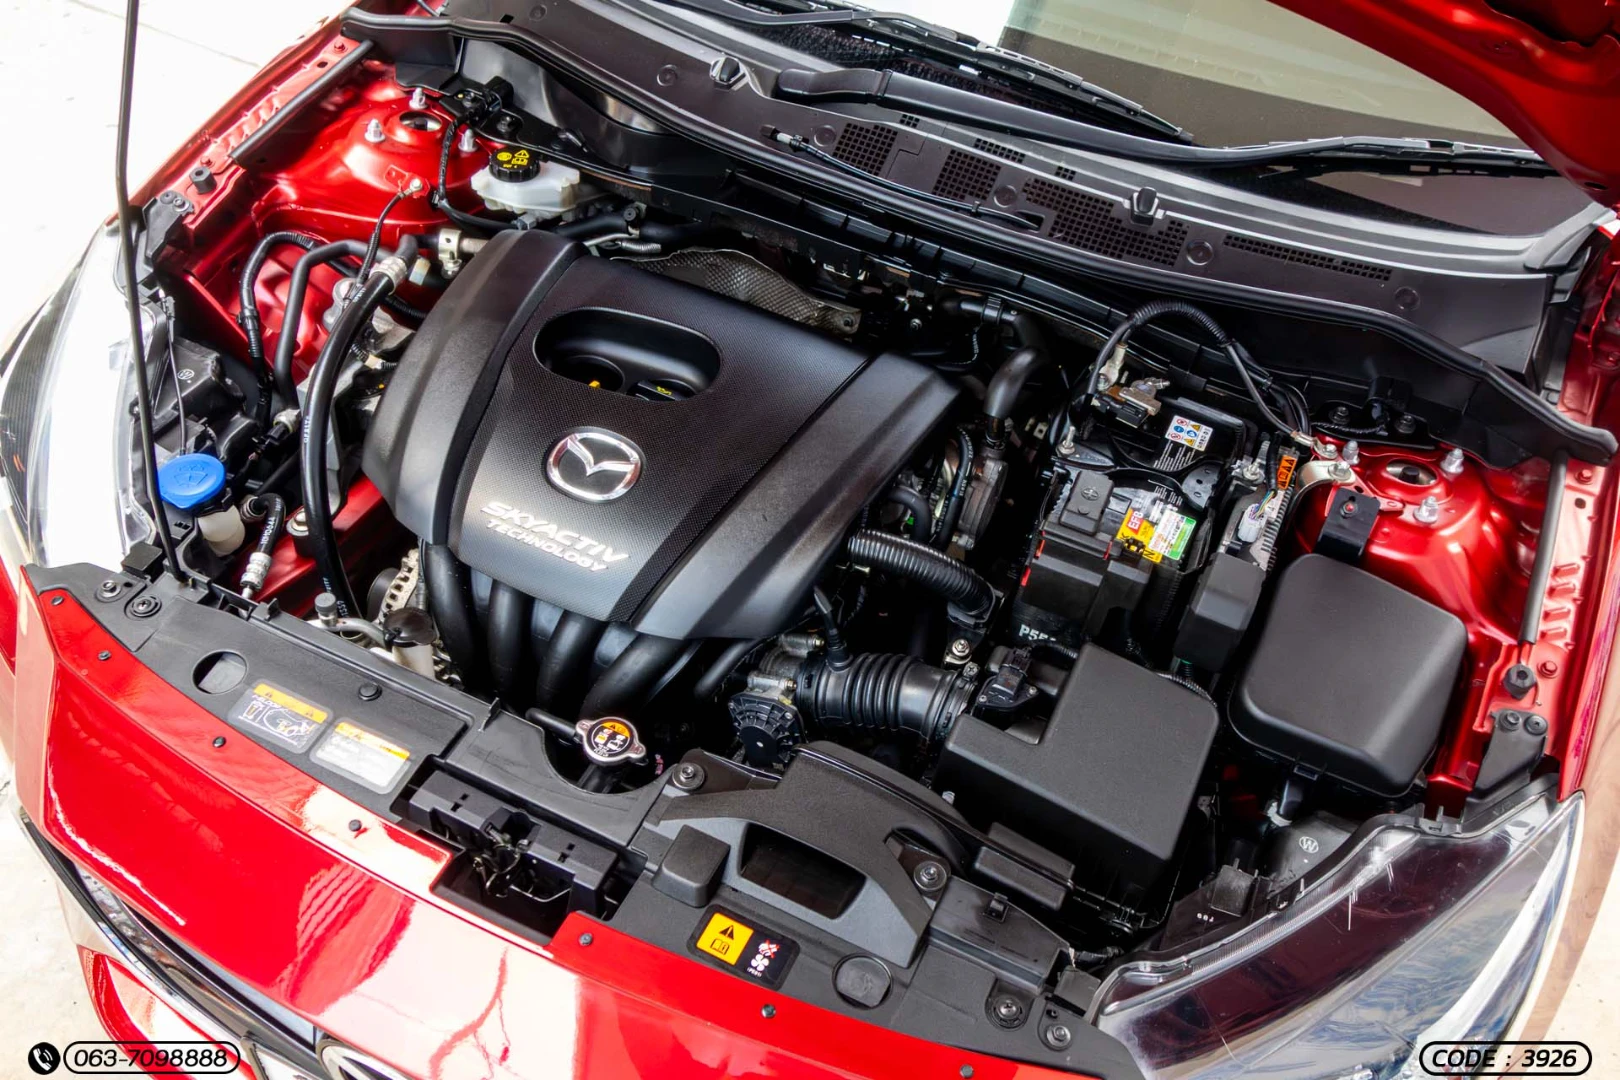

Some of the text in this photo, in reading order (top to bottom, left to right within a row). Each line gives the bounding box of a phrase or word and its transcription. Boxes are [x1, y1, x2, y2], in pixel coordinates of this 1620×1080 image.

[480, 501, 631, 563] SKYACTIV
[487, 518, 608, 571] TECHNOLOGY
[1128, 510, 1144, 530] EFB
